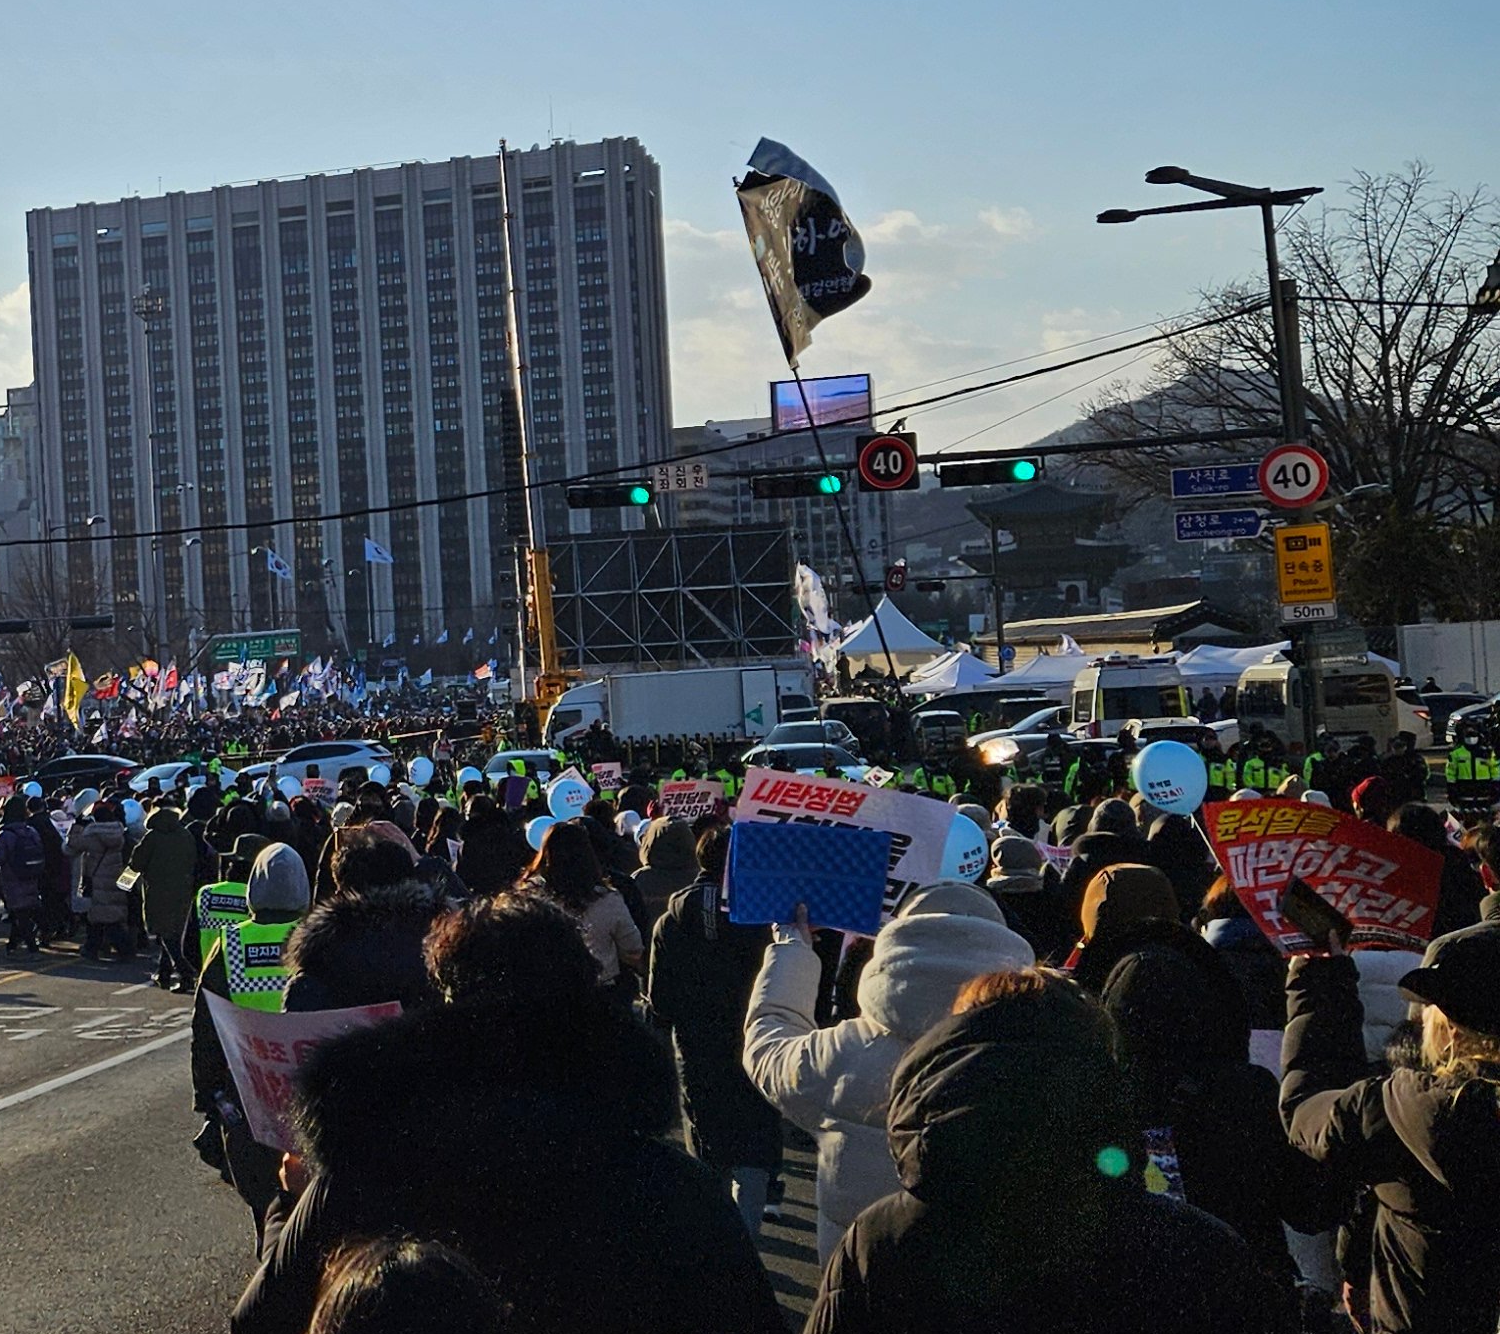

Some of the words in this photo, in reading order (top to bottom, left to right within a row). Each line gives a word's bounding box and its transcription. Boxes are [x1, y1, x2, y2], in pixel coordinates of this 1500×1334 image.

[873, 450, 902, 475] 40
[1188, 468, 1231, 483] 사직로
[1273, 462, 1311, 489] 40
[1190, 483, 1230, 494] Sajik-ro
[1180, 514, 1222, 529] 삼청로
[1179, 528, 1247, 539] Samcheong-ro
[1284, 559, 1324, 575] 단속중
[1292, 578, 1320, 587] Photo
[1293, 605, 1326, 619] 50m
[750, 778, 868, 818] 내란정범
[1217, 806, 1341, 843] 윤석열을
[1226, 838, 1400, 888] 파면하고
[1255, 880, 1430, 931] 구하라!
[247, 945, 280, 958] 딴지자
